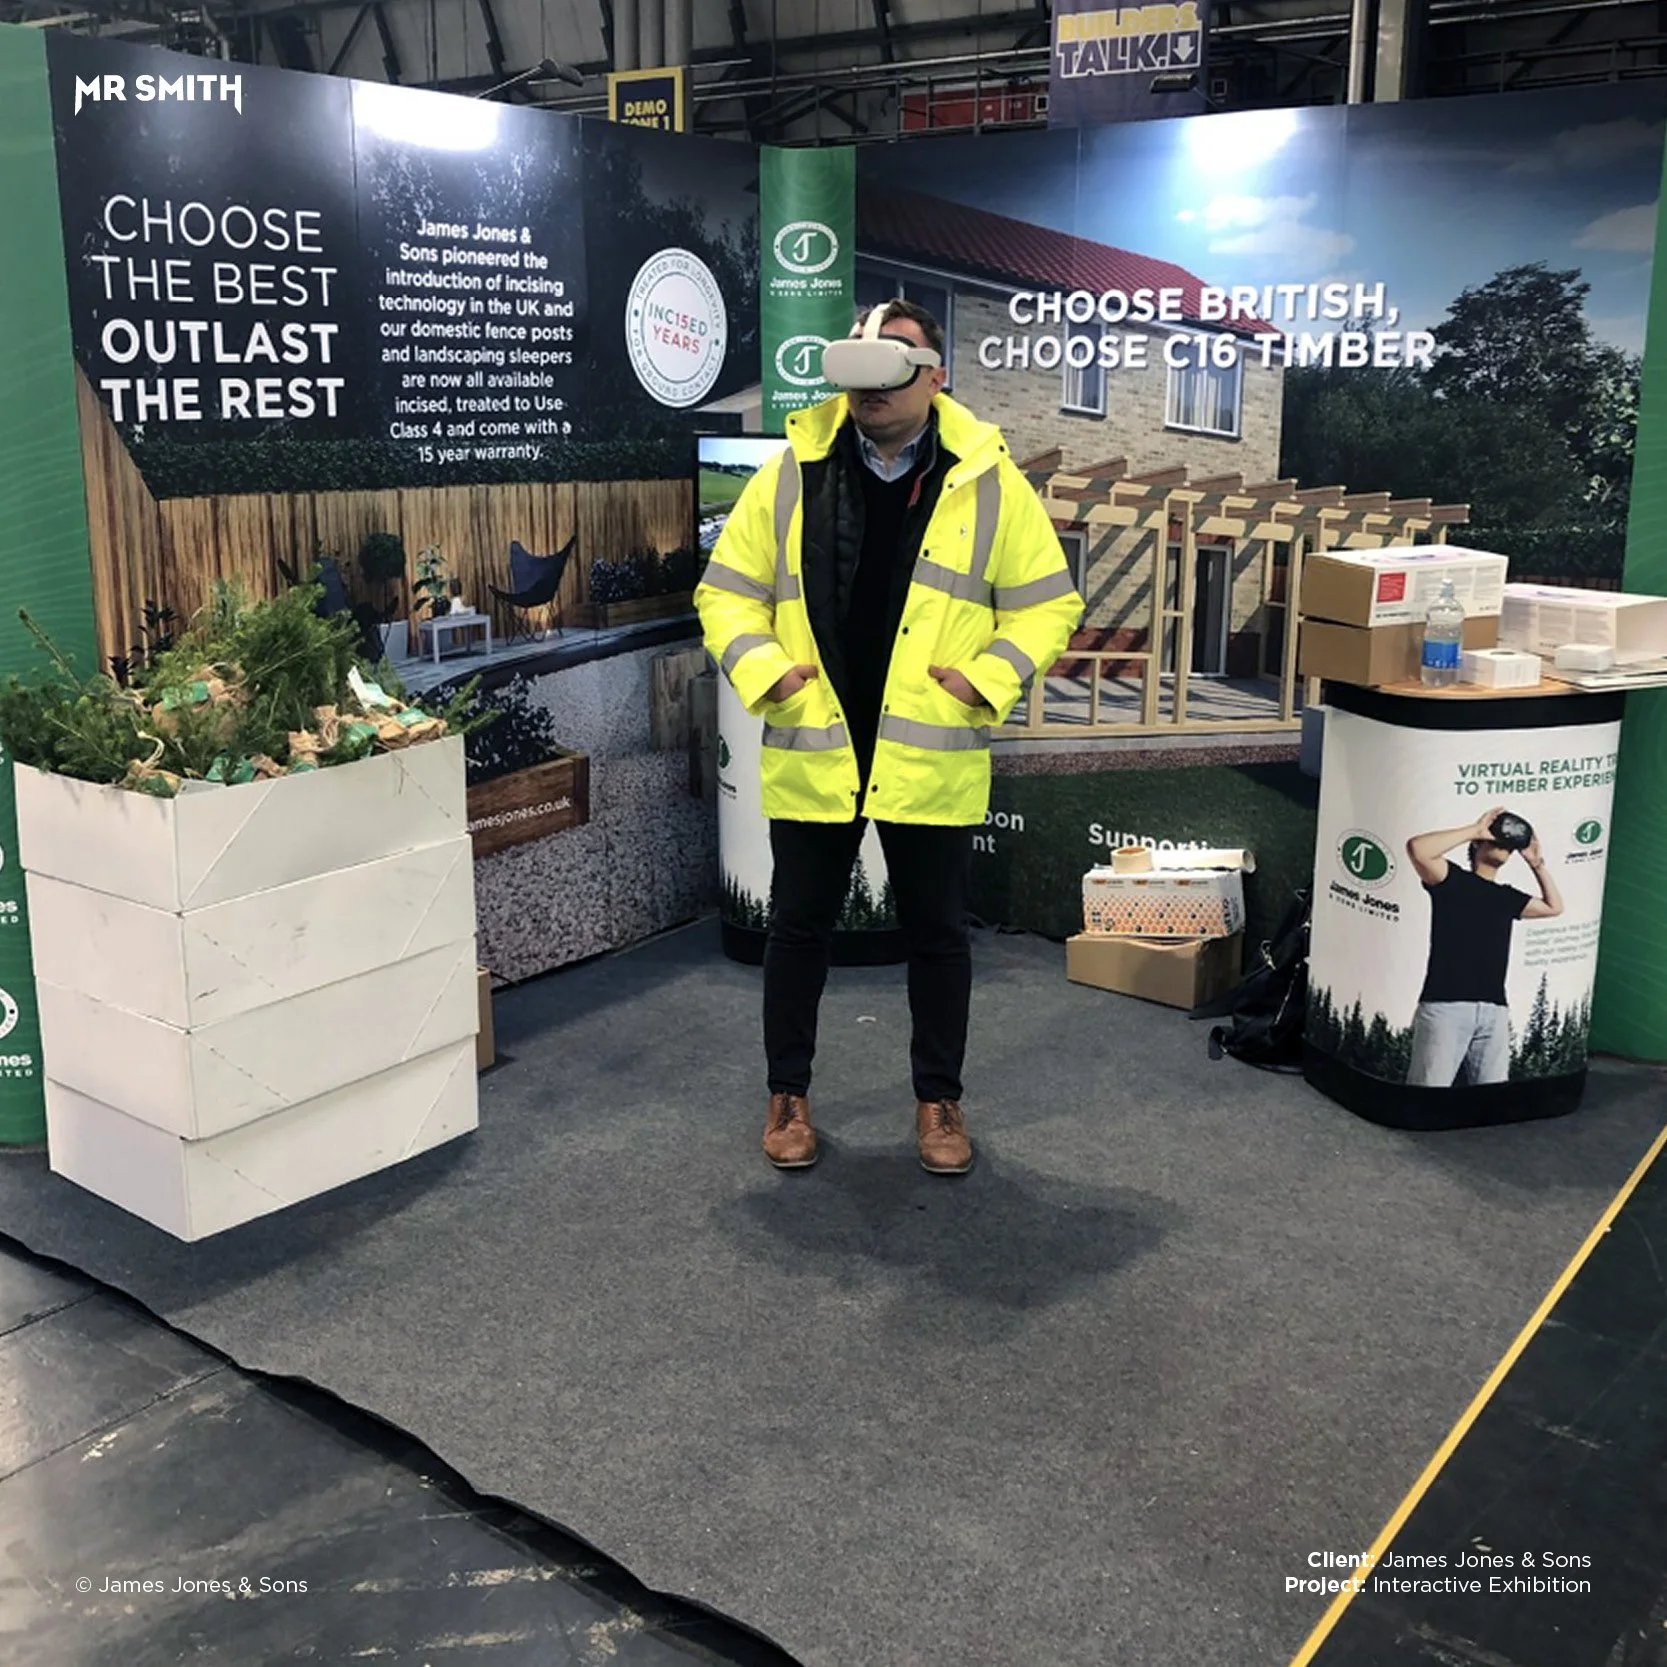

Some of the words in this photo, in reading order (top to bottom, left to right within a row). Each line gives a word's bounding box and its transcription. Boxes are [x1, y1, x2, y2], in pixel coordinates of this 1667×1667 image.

[1058, 1, 1198, 43] BUILDERS
[625, 99, 667, 117] DEMO
[104, 194, 323, 253] CHOOSE
[417, 219, 469, 239] James
[472, 223, 517, 243] Jones
[520, 227, 532, 244] &
[400, 242, 438, 262] Sons
[442, 246, 520, 268] pioneered
[523, 251, 548, 270] the
[92, 255, 194, 302] THE
[213, 262, 338, 307] BEST
[385, 267, 482, 291] introduction
[485, 275, 502, 291] of
[505, 275, 564, 297] incising
[770, 277, 807, 289] James
[378, 294, 466, 316] technology
[470, 297, 484, 314] in
[488, 298, 512, 315] the
[515, 300, 540, 316] UK
[543, 301, 574, 317] and
[1009, 287, 1184, 325] CHOOSE
[1199, 282, 1400, 326] BRITISH,
[102, 319, 339, 364] OUTLAST
[380, 323, 406, 337] our
[411, 320, 481, 339] domestic
[485, 321, 527, 340] fence
[531, 325, 573, 342] posts
[653, 324, 700, 355] YEARS
[381, 345, 410, 363] and
[414, 345, 505, 366] landscaping
[509, 347, 572, 366] sleepers
[979, 335, 1149, 370] CHOOSE
[1163, 335, 1236, 369] C16
[1254, 332, 1436, 369] TIMBER
[402, 373, 426, 388] are
[430, 373, 462, 388] now
[466, 371, 484, 388] all
[487, 371, 554, 388] available
[100, 378, 202, 422] THE
[220, 377, 345, 420] REST
[395, 396, 452, 415] incised,
[456, 396, 511, 412] treated
[515, 397, 531, 411] to
[535, 396, 564, 411] Use
[390, 421, 428, 439] Class
[432, 421, 442, 437] 4
[447, 420, 475, 437] and
[479, 422, 520, 436] come
[524, 418, 558, 434] with
[562, 421, 572, 434] a
[418, 446, 434, 463] 15
[437, 447, 470, 465] year
[474, 444, 545, 461] warranty.
[1458, 761, 1534, 779] VIRTUAL
[1540, 756, 1603, 774] REALITY
[1454, 781, 1479, 795] TO
[1485, 778, 1548, 794] TIMBER
[466, 796, 571, 832] amesjones.co.uk
[1363, 893, 1399, 913] Jones
